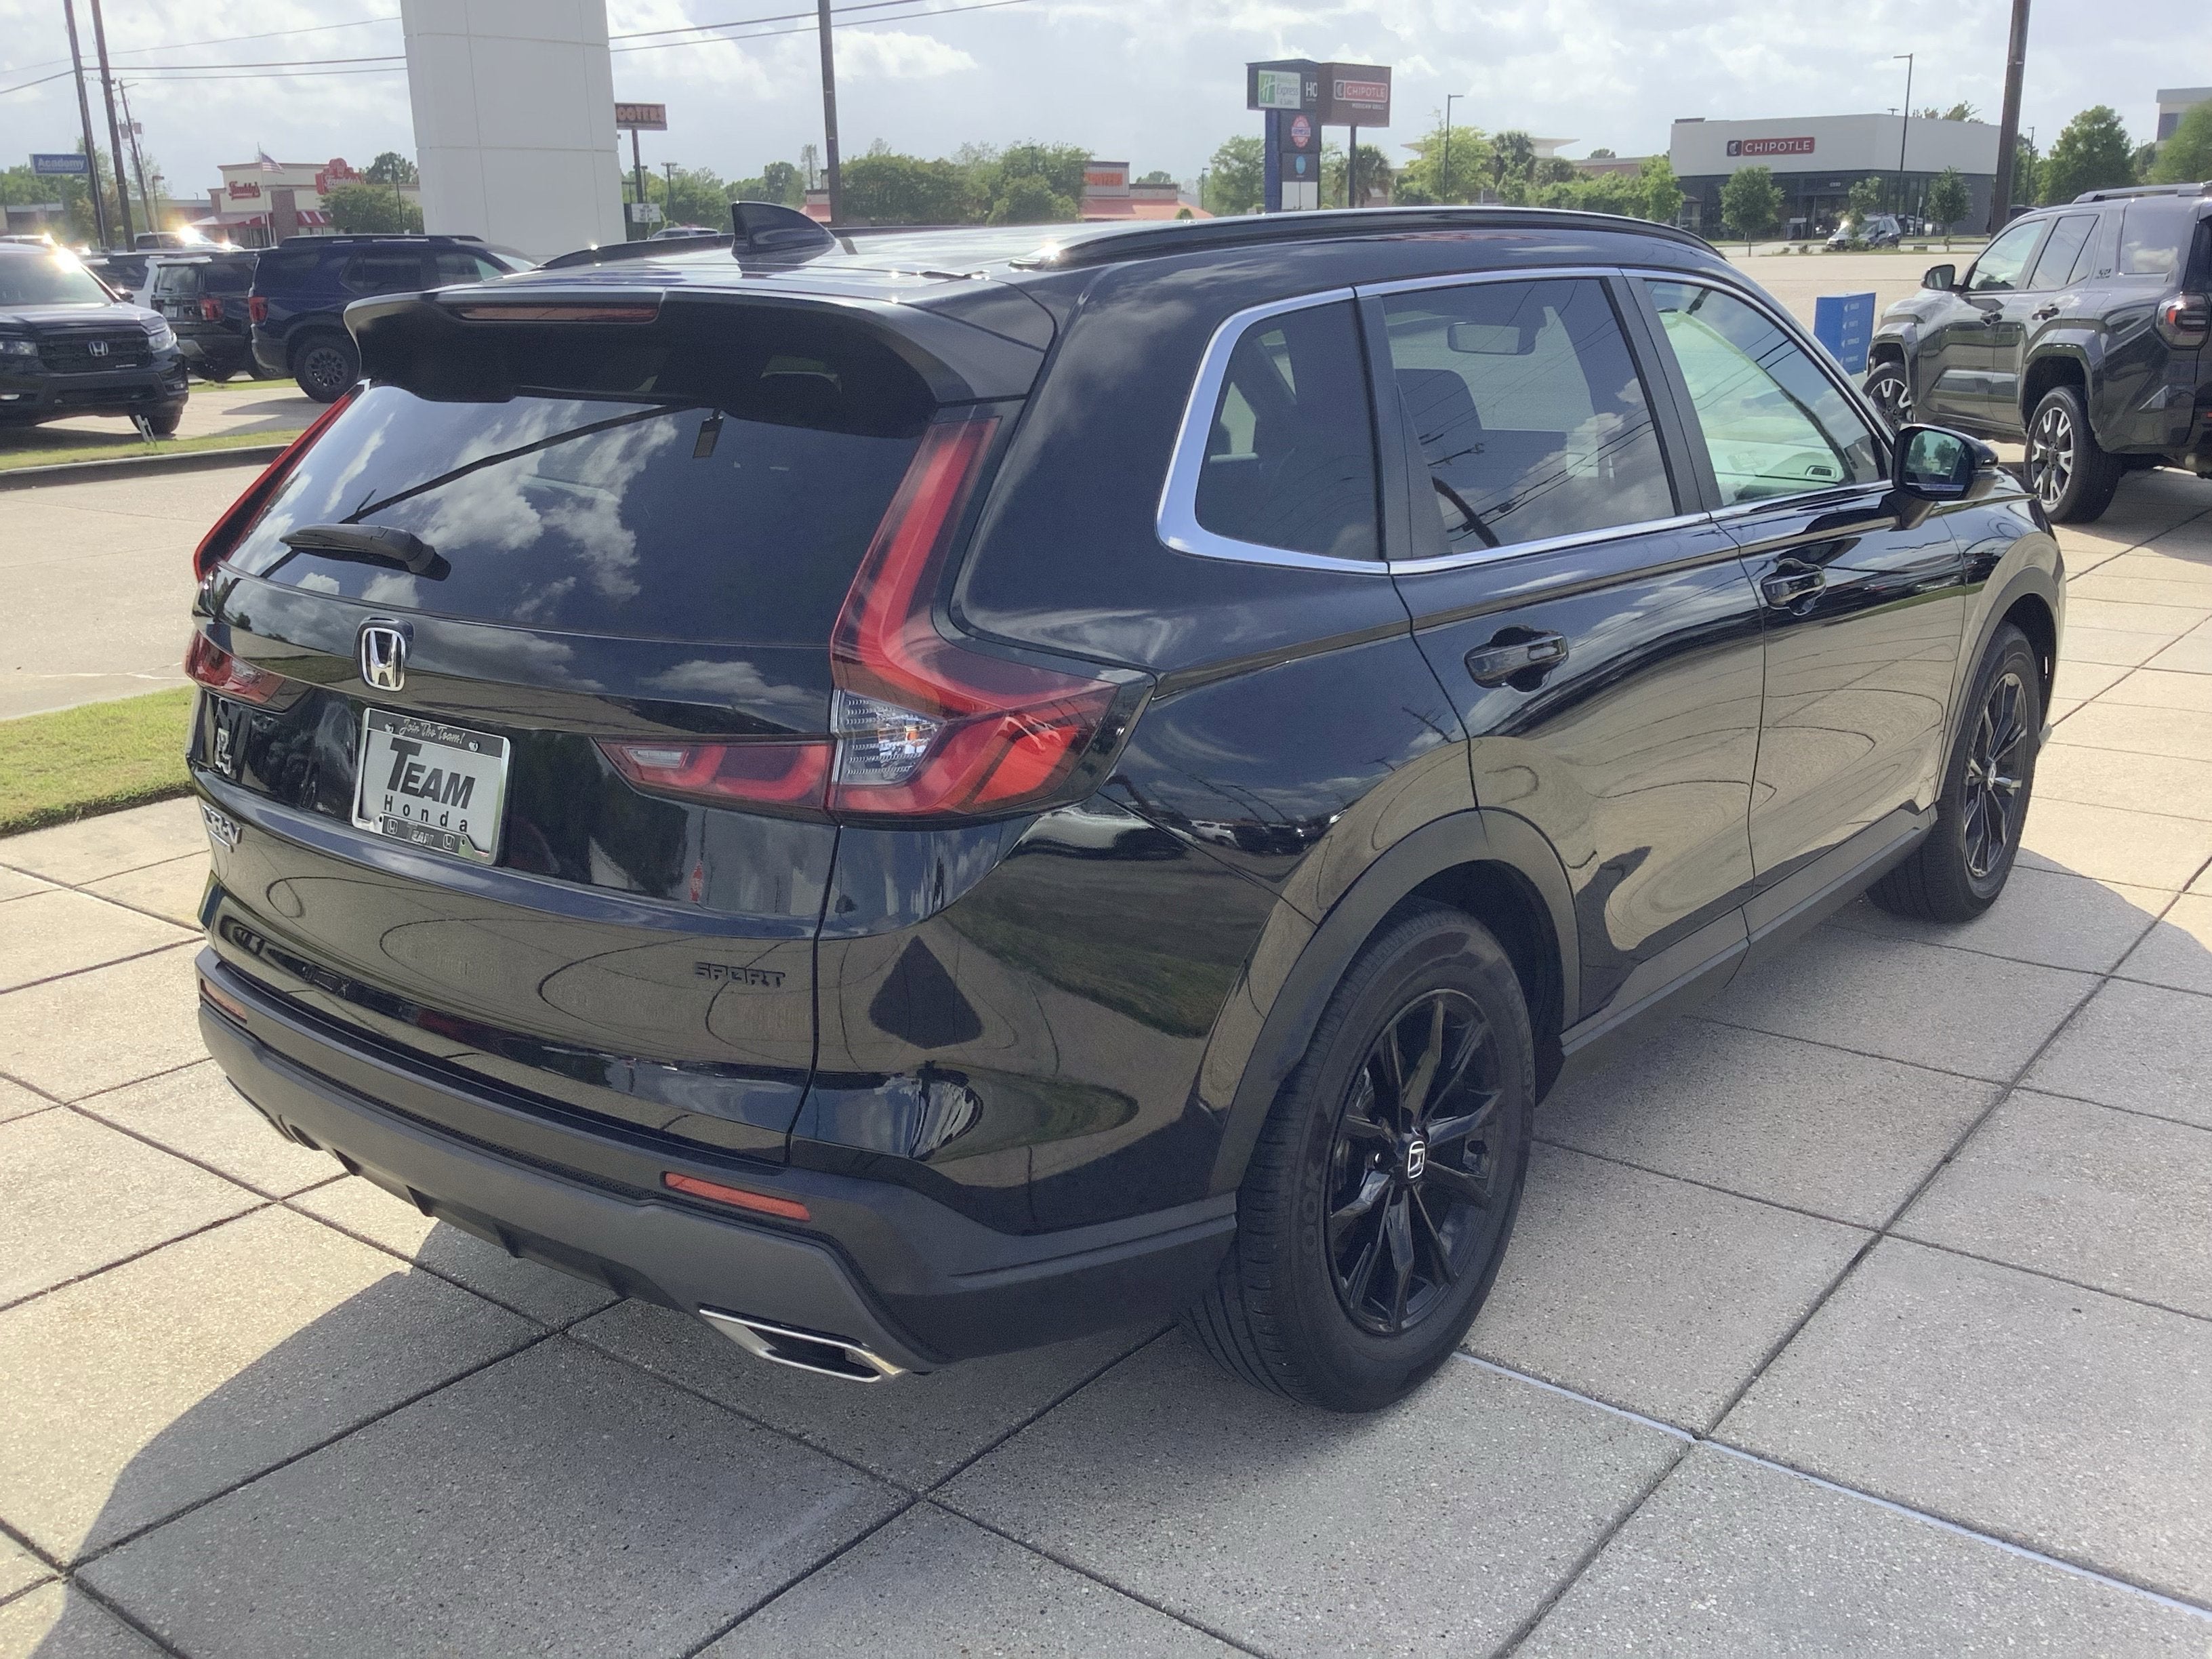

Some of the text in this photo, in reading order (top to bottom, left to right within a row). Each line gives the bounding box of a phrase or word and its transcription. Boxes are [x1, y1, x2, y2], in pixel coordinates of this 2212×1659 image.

[1276, 83, 1299, 96] Express
[1305, 81, 1318, 98] HO
[1347, 85, 1385, 98] CHIPOTLE
[617, 106, 664, 122] OOTERS
[1745, 140, 1811, 153] CHIPOTLE
[38, 157, 85, 170] Academy
[398, 718, 466, 744] Join The Team!
[387, 737, 476, 809] TEAM
[384, 794, 468, 833] Honda
[694, 962, 785, 987] SPORT
